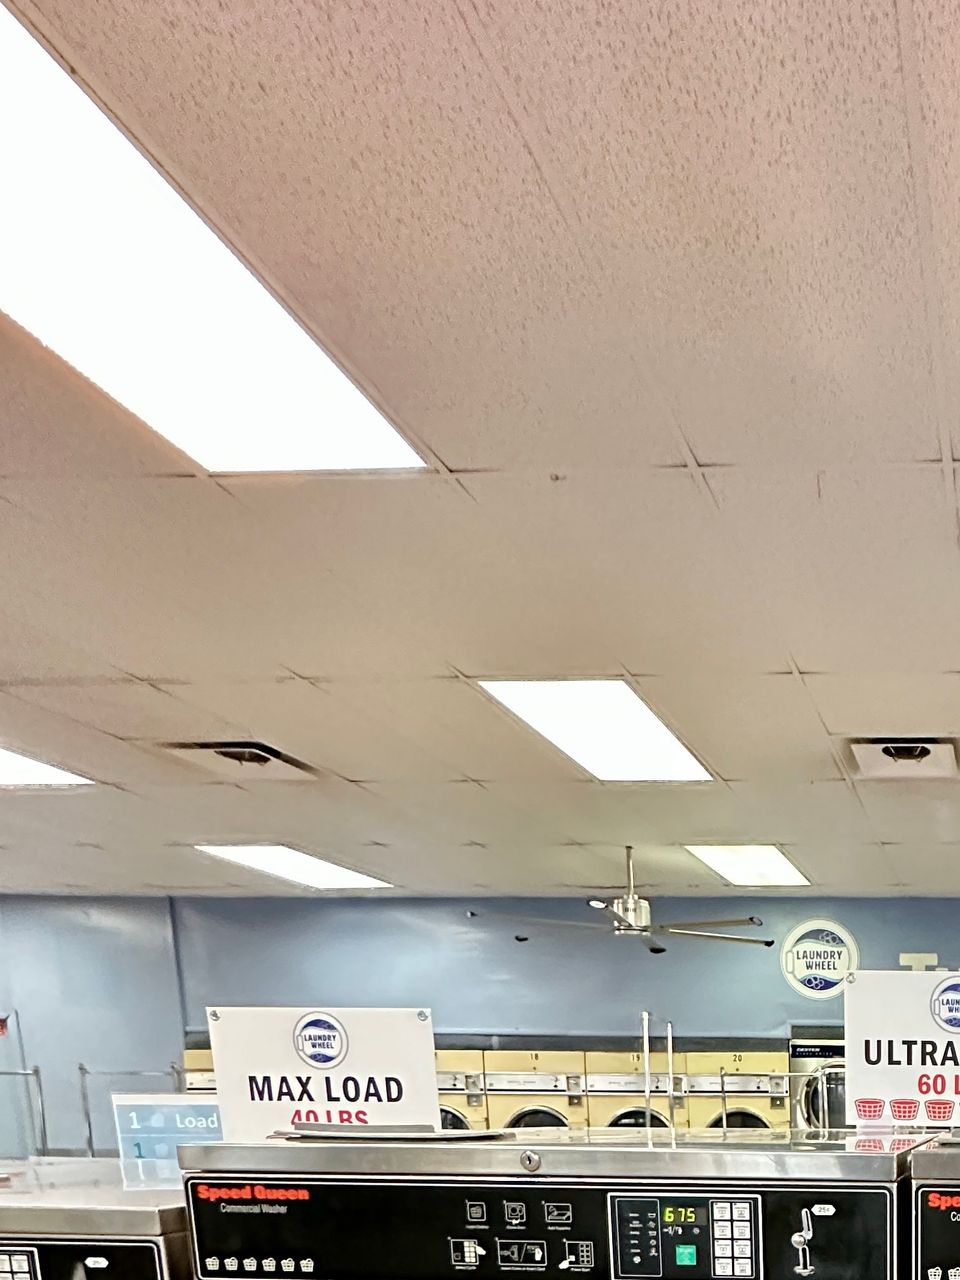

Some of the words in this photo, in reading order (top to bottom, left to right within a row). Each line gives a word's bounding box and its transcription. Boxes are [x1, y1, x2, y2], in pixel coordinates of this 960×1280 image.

[796, 950, 843, 960] LAUNDRY
[805, 961, 838, 970] WHEEL
[303, 1034, 337, 1042] LAUNDRY
[310, 1041, 334, 1049] WHEEL
[530, 1053, 539, 1061] 18
[631, 1053, 641, 1062] 19
[864, 1039, 960, 1067] ULTRA
[732, 1054, 743, 1062] 20
[248, 1075, 314, 1102] MAX
[325, 1076, 404, 1103] LOAD
[918, 1074, 946, 1095] 60
[129, 1111, 142, 1129] 1
[176, 1112, 219, 1128] Load
[197, 1185, 252, 1201] Speed
[254, 1185, 310, 1200] Queen
